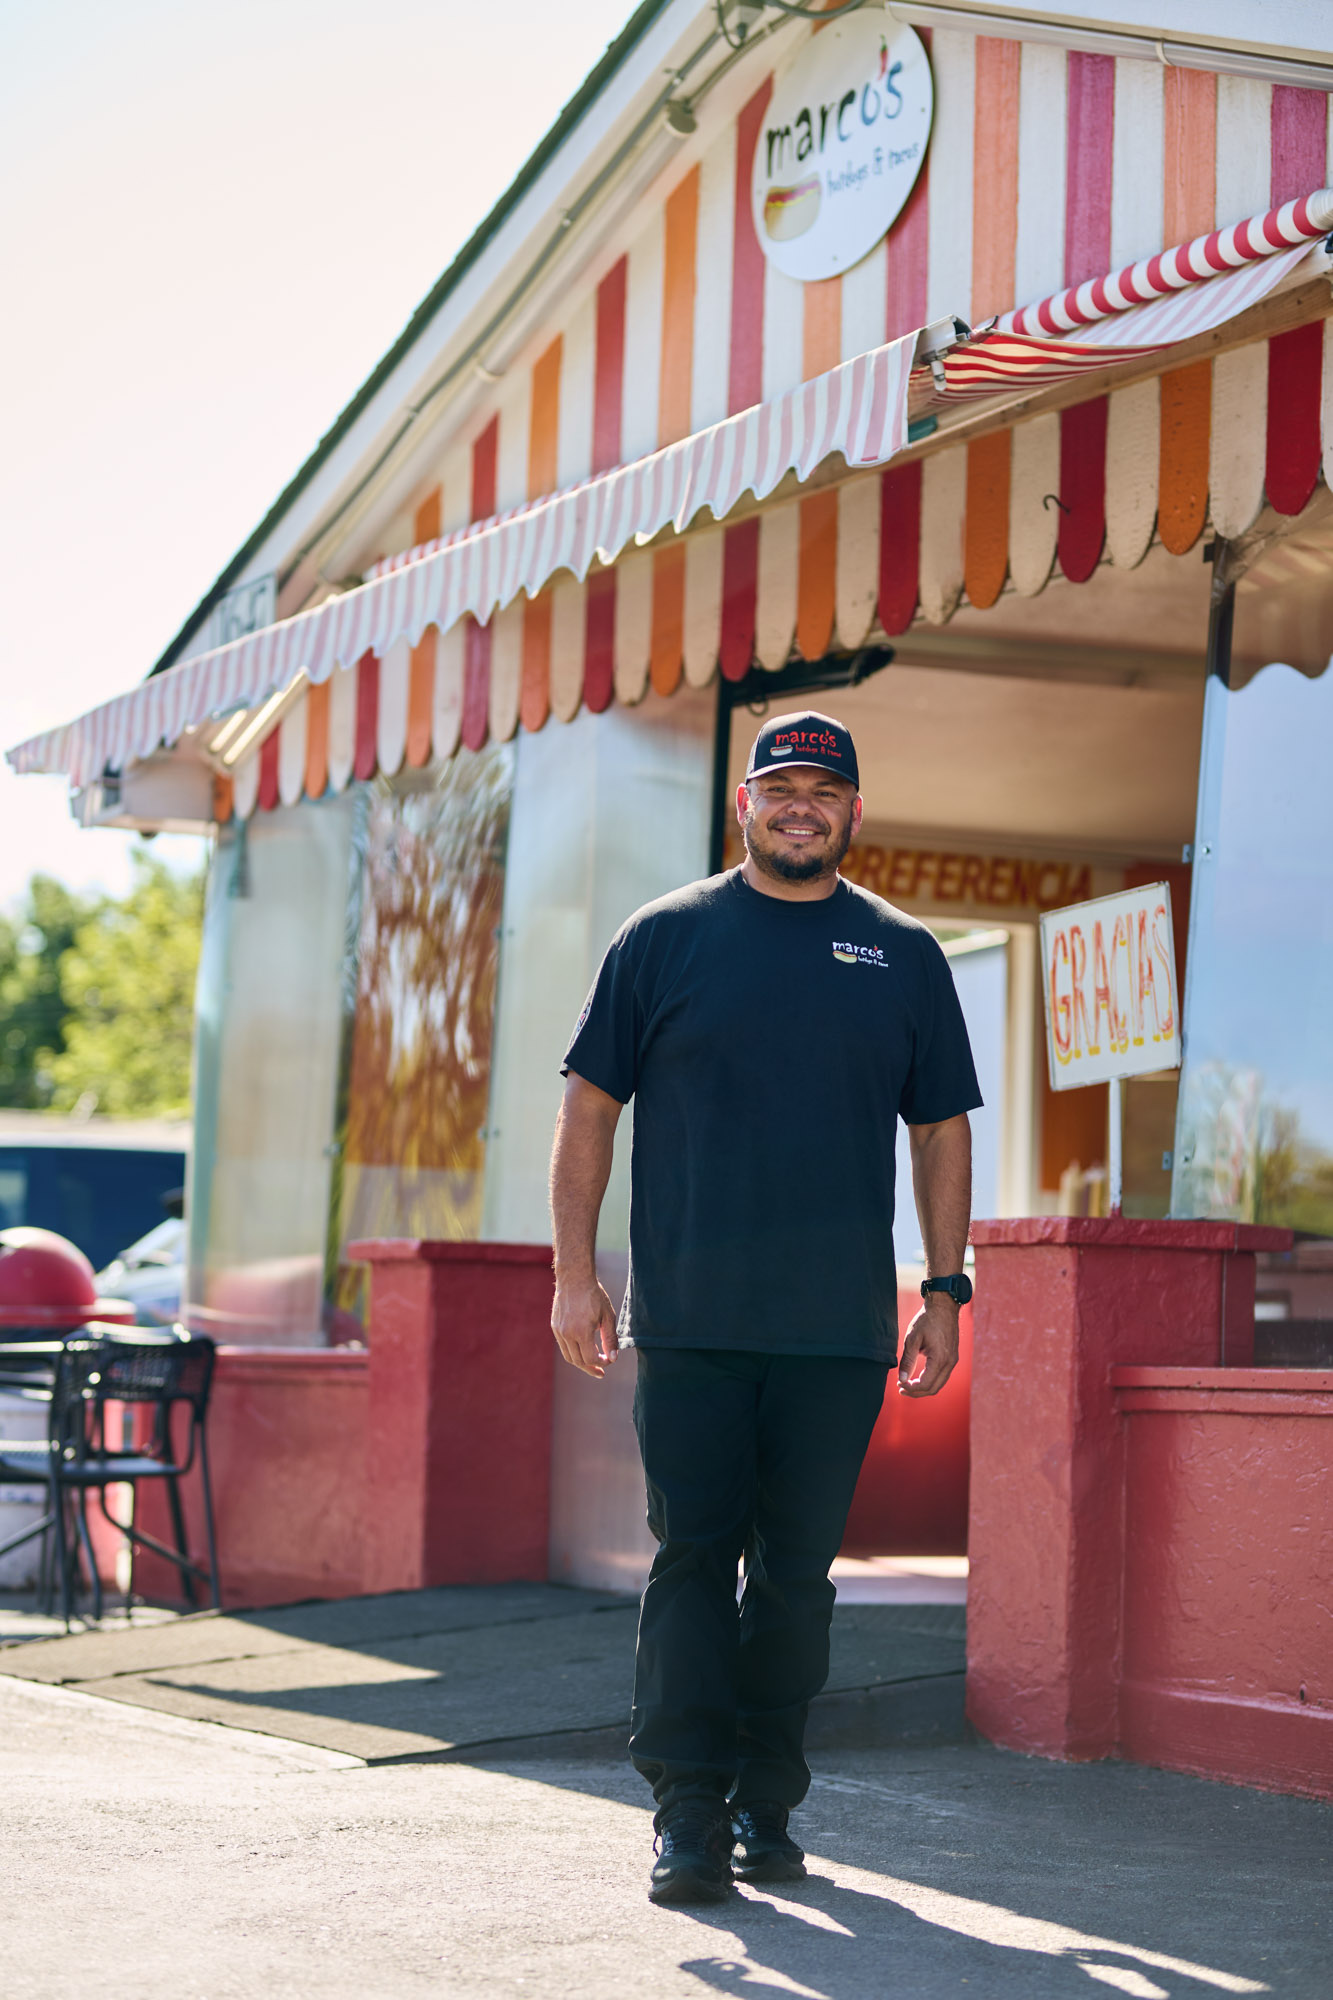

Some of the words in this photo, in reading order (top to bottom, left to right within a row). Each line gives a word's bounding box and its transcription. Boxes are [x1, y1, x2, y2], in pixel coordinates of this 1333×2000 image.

[767, 34, 904, 179] marco's
[775, 729, 836, 747] marco's
[832, 942, 884, 959] marco's
[1051, 904, 1174, 1066] GRACIAS
